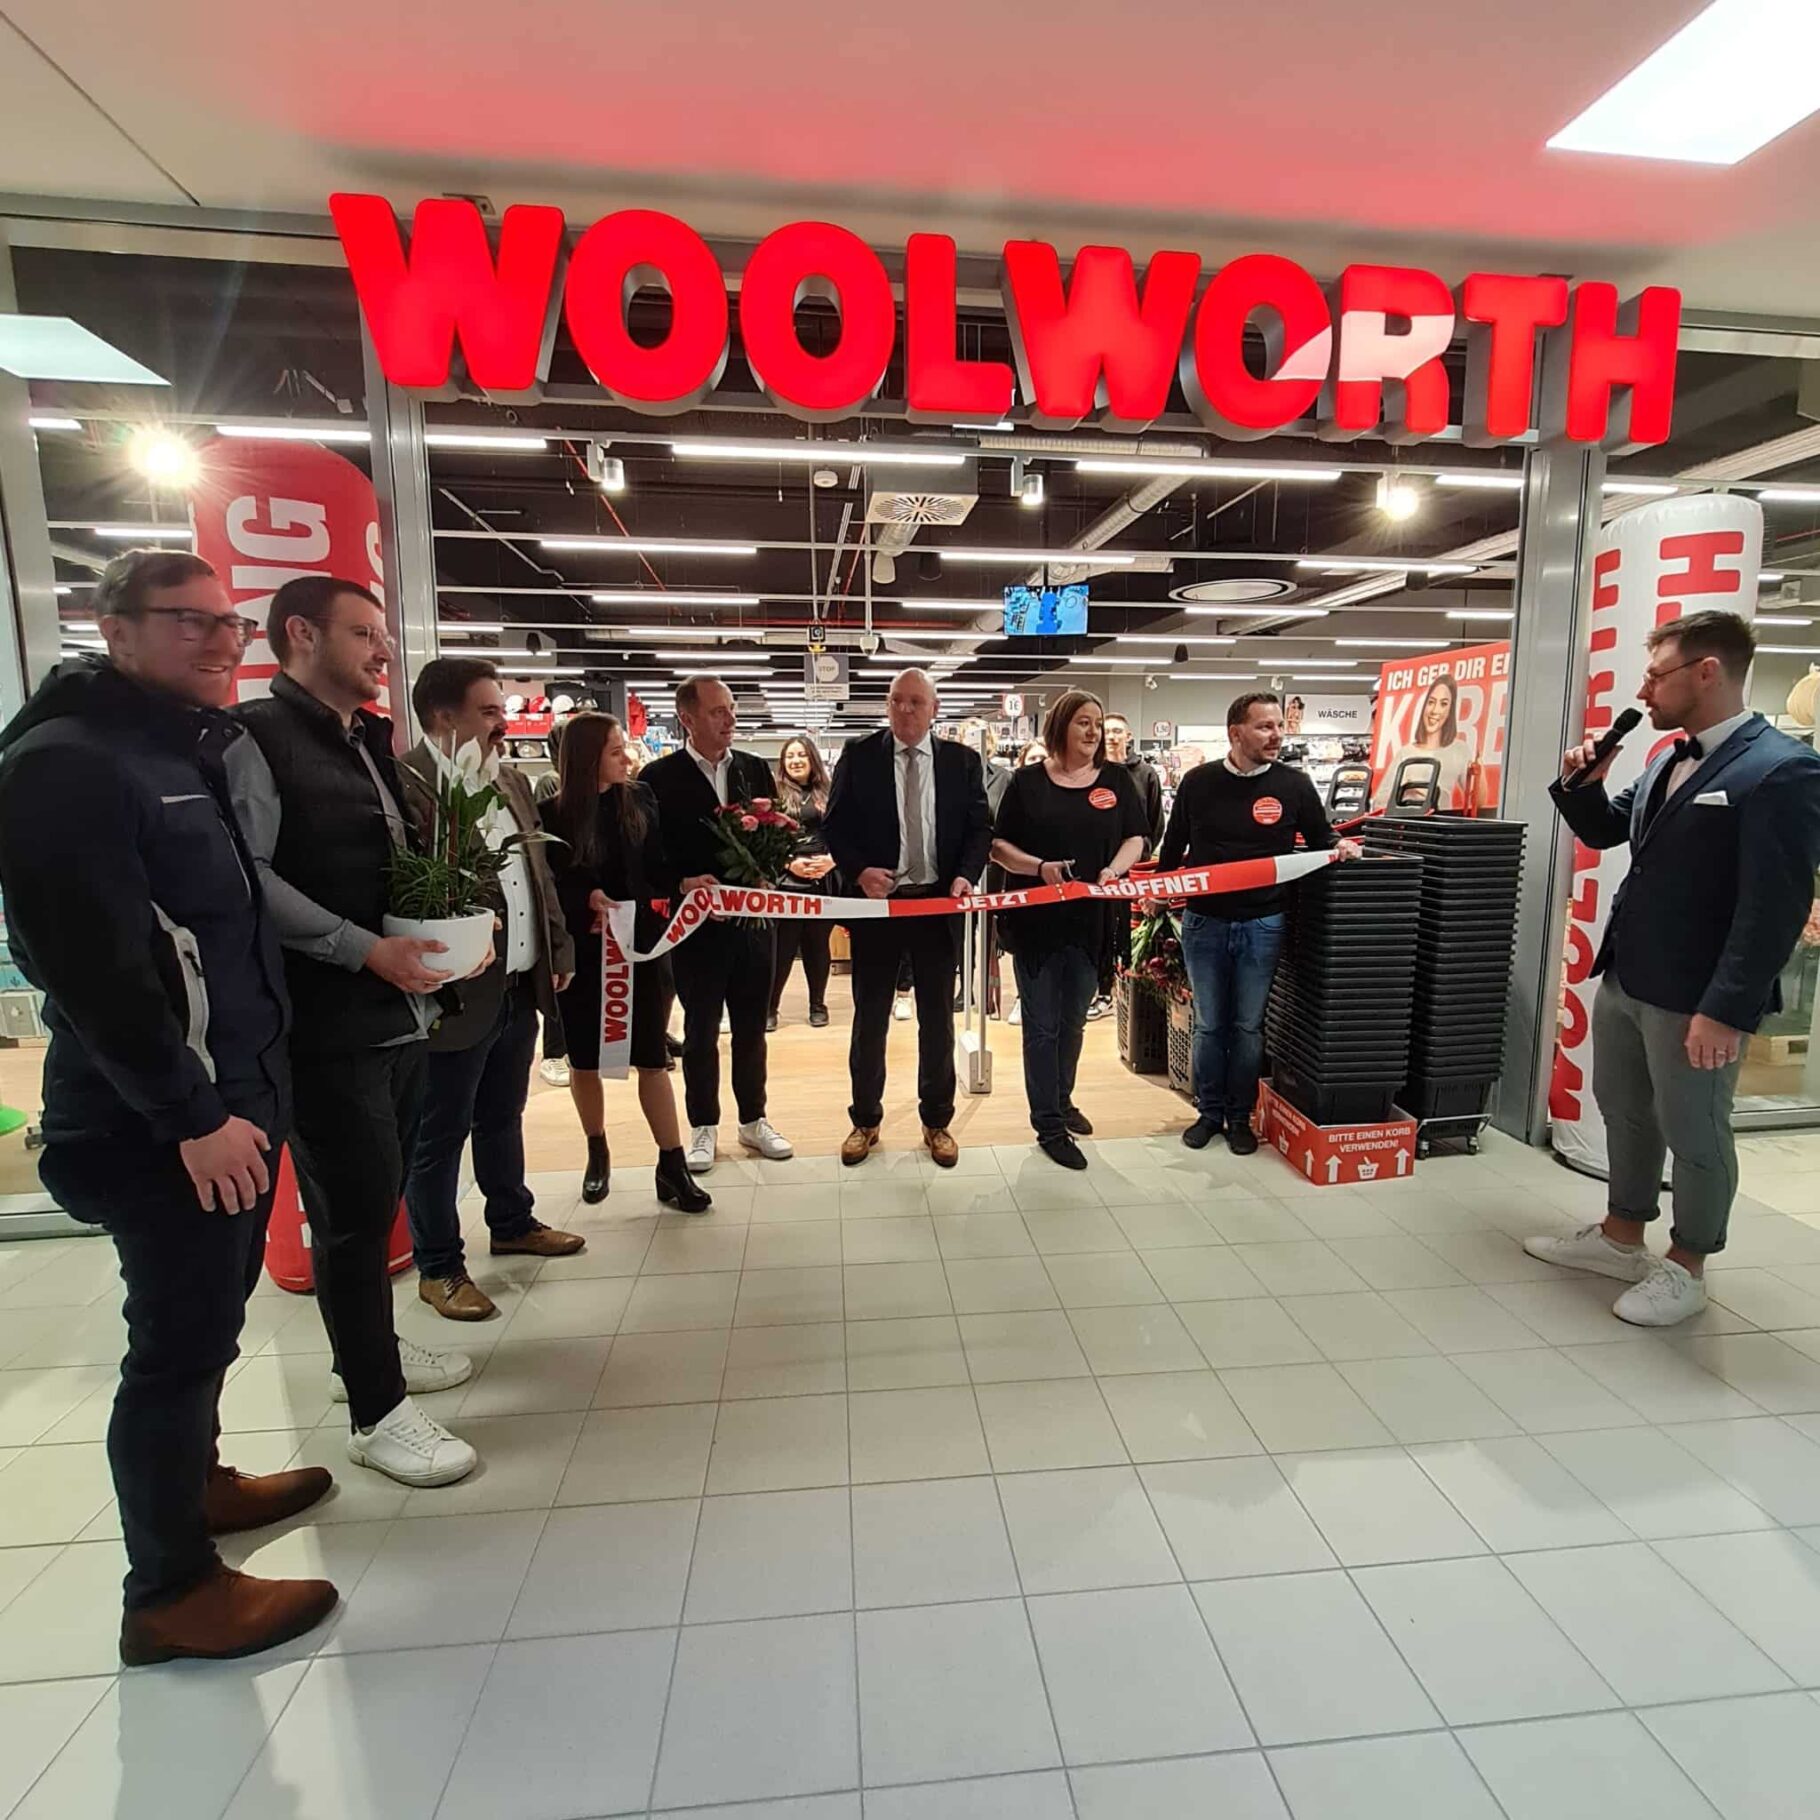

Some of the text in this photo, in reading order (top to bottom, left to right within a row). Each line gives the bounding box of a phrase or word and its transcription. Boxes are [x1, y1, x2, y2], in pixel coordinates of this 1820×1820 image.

[329, 192, 1682, 446] WOOLWORTH
[1387, 669, 1414, 692] ICH
[1454, 657, 1487, 681] DIR
[1318, 709, 1358, 718] WÄSCHE
[666, 872, 1210, 944] WOOLWORTH JETZT ERÖFFNET
[604, 922, 629, 1043] WOOLW
[1328, 1127, 1411, 1143] BITTE EINEN KORB
[1339, 1140, 1399, 1153] VERWENDEN!
